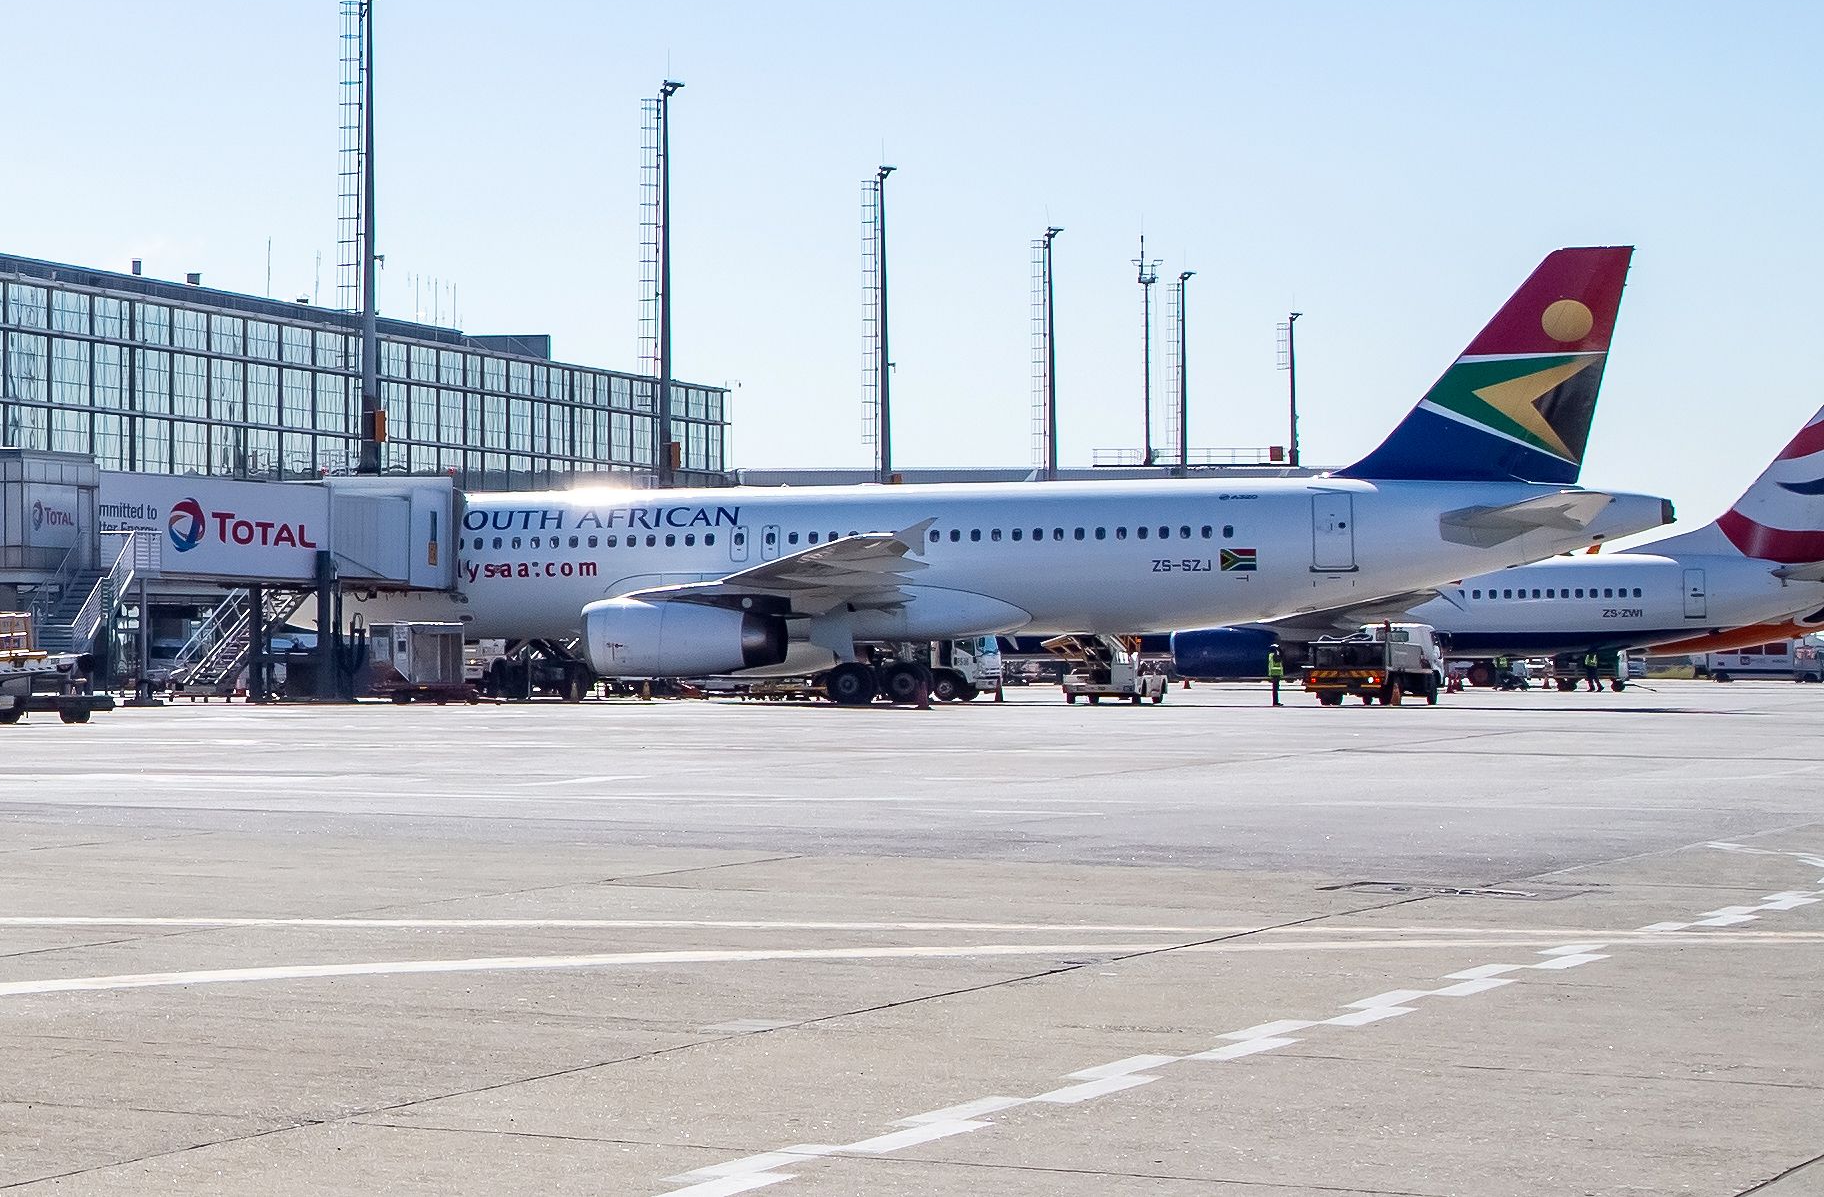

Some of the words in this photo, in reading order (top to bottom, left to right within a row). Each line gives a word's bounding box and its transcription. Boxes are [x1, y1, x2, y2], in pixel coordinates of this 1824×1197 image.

[43, 506, 74, 527] TOTAL
[98, 502, 144, 519] mmitted
[147, 504, 158, 520] to
[462, 509, 565, 531] OUTH
[574, 506, 741, 530] AFRICAN
[211, 511, 317, 549] TOTAL
[457, 558, 598, 583] lysaa.com
[1152, 559, 1212, 572] ZS-SZJ
